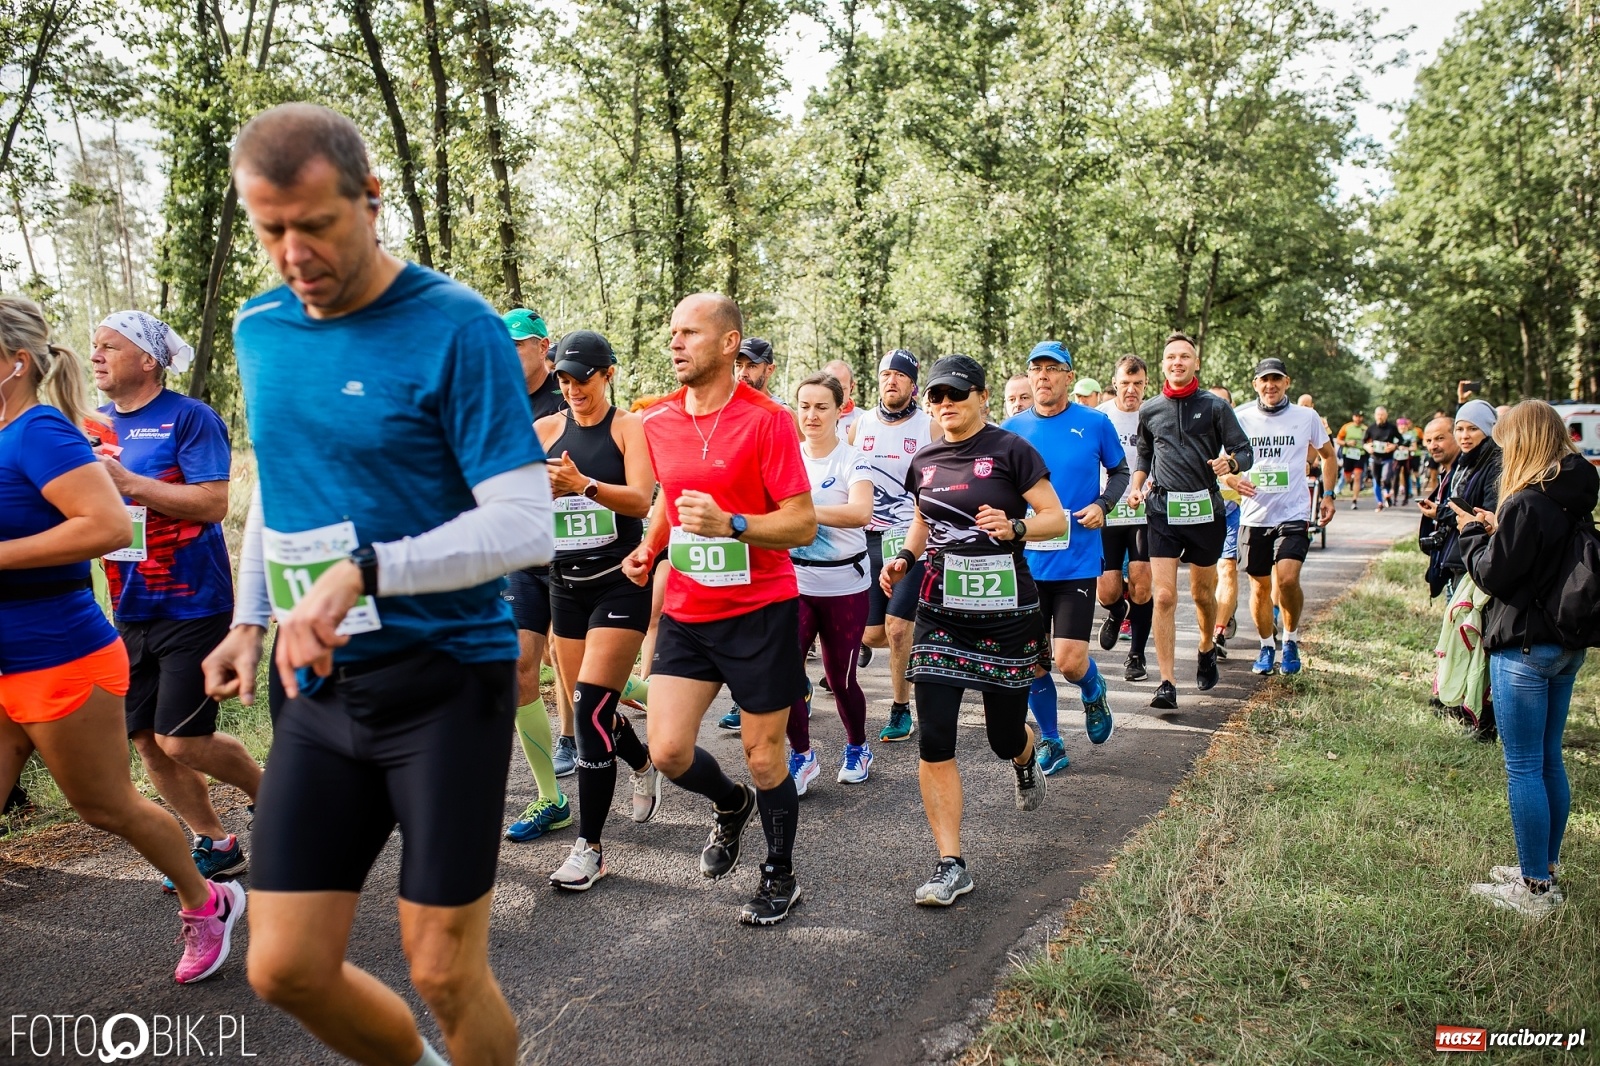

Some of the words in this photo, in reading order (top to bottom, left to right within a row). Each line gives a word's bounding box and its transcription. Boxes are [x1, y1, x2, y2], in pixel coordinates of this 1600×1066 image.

[1250, 437, 1271, 447] OWA
[1273, 435, 1295, 446] HUTA
[1259, 447, 1282, 458] TEAM
[1259, 473, 1278, 486] 32
[1117, 505, 1136, 518] 56
[1180, 502, 1200, 517] 39
[563, 512, 598, 536] 131
[888, 538, 904, 556] 16
[689, 546, 726, 571] 90
[958, 573, 1002, 597] 132
